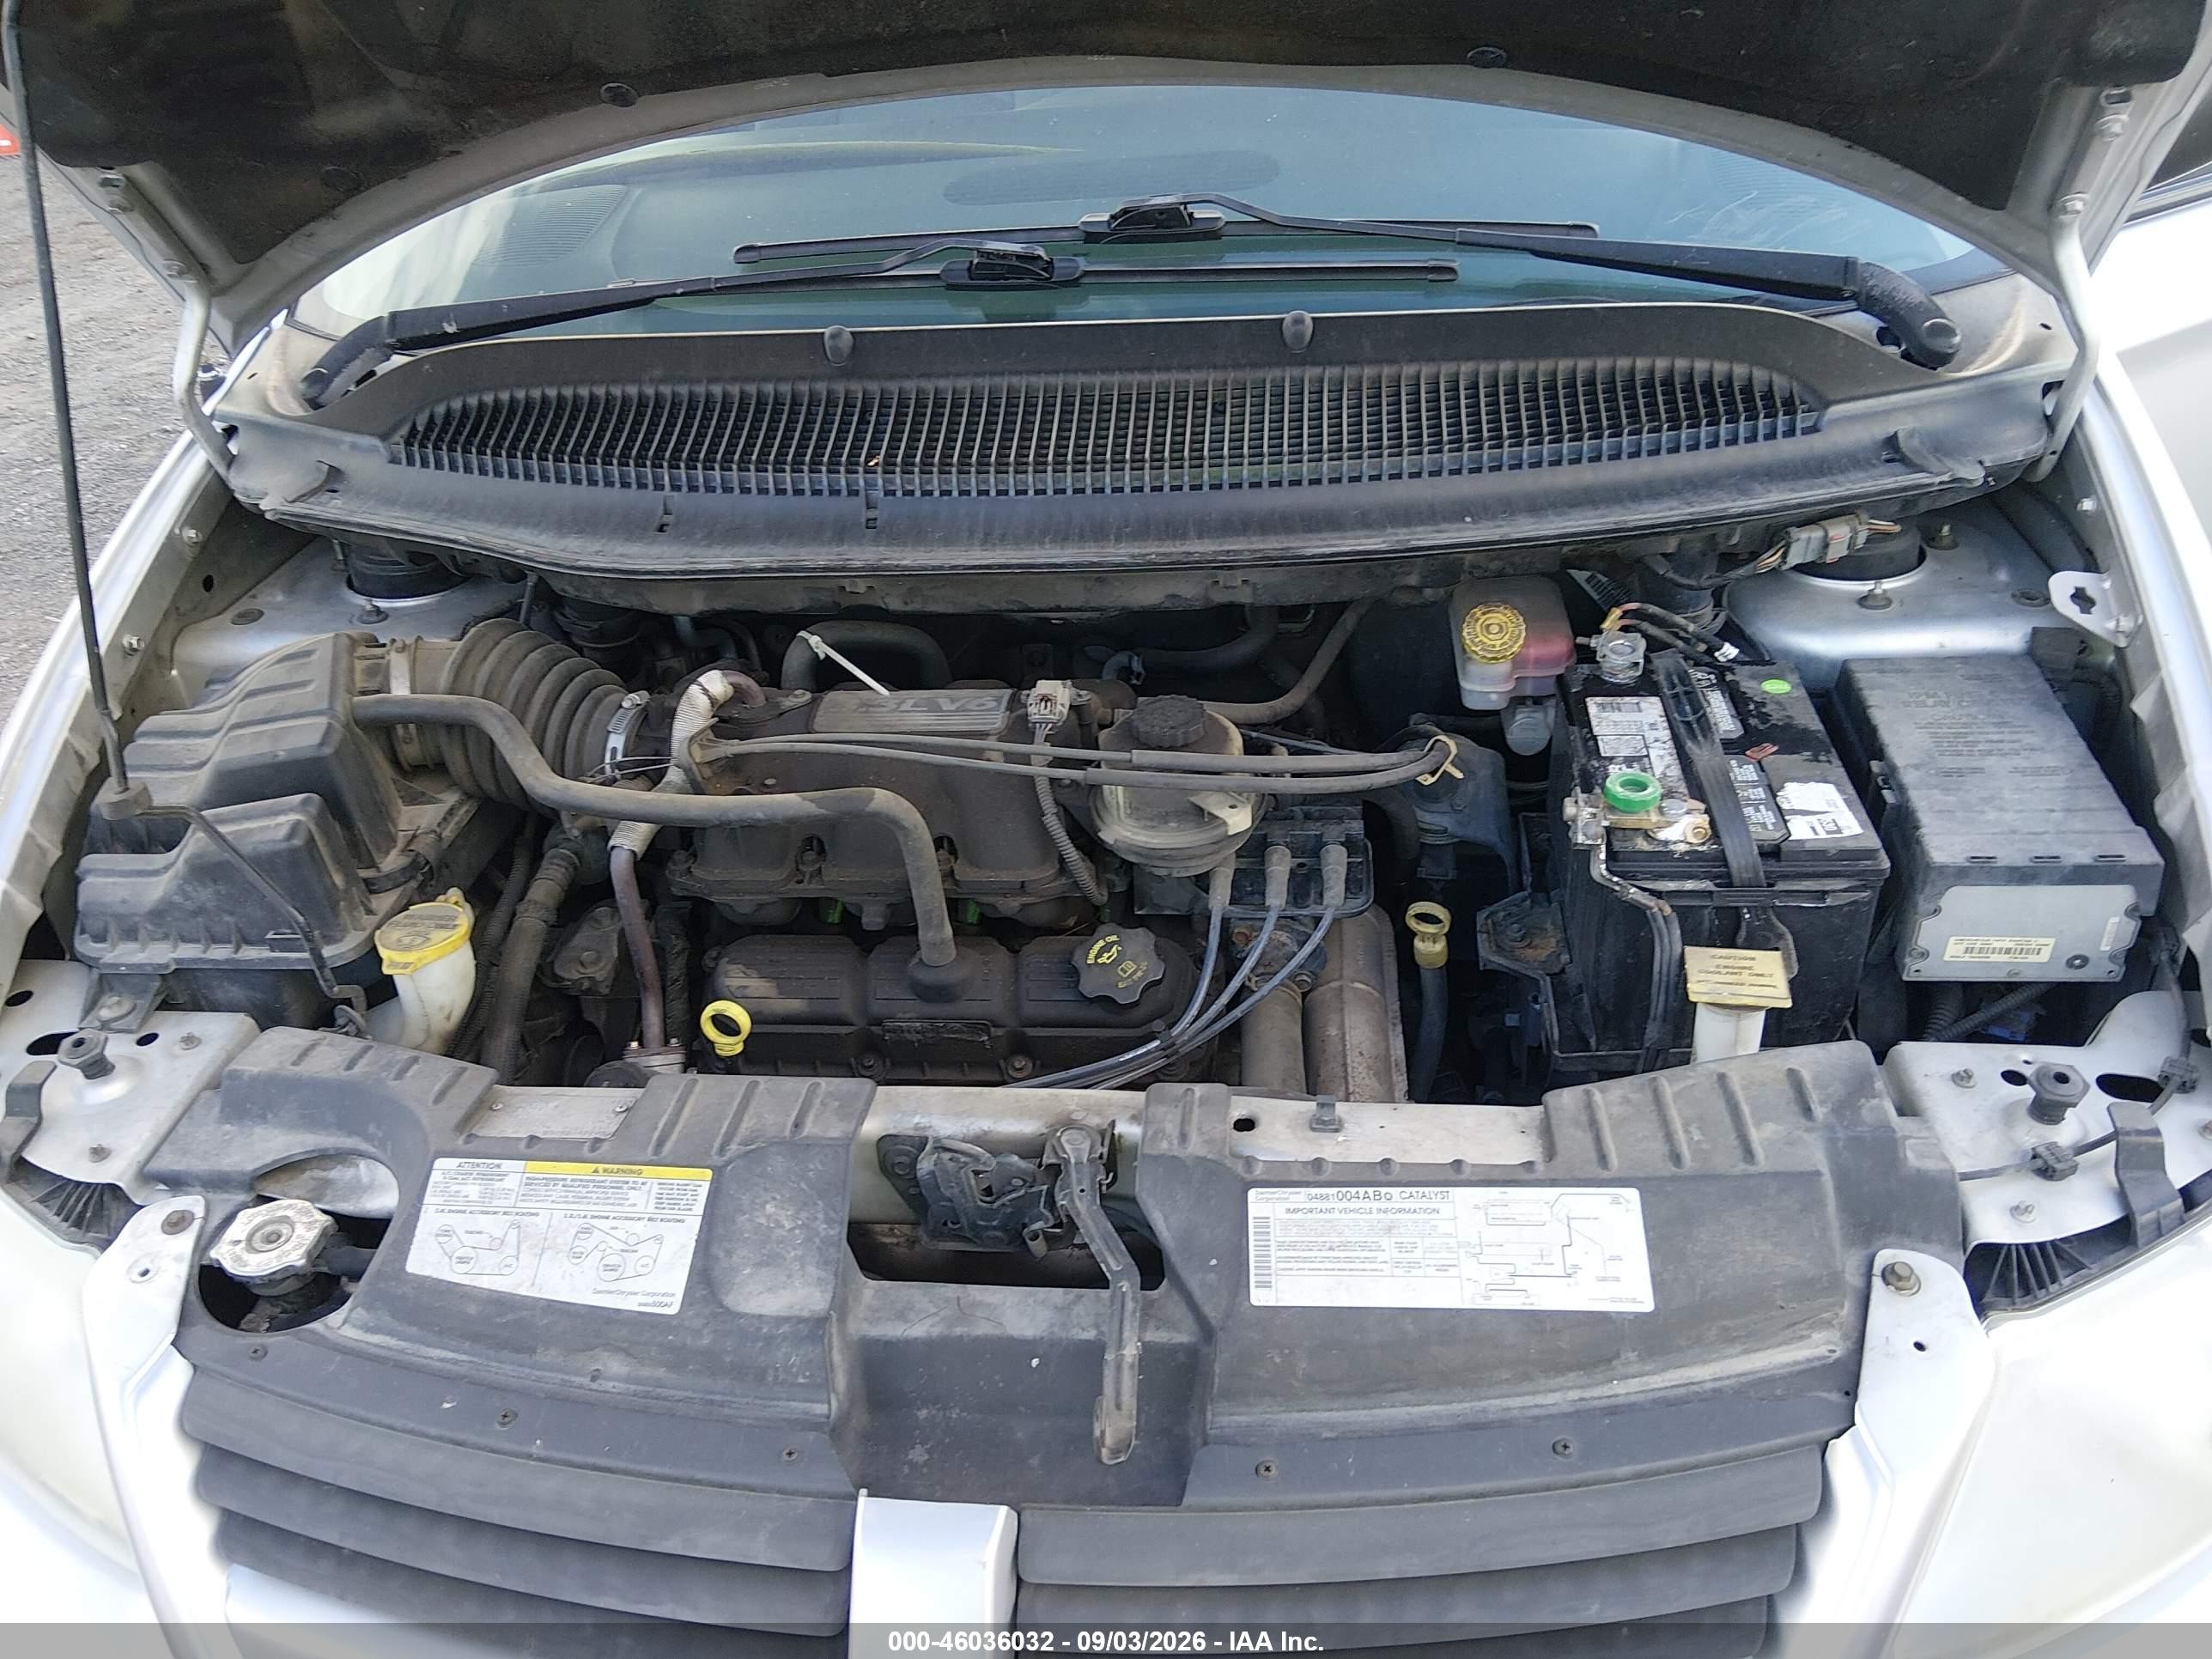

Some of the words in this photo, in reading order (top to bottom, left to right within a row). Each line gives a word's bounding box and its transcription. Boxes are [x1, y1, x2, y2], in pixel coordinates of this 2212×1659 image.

[938, 696, 998, 711] V6
[1086, 938, 1107, 964] ENGINE
[1104, 934, 1121, 943] OIL
[601, 1167, 644, 1176] WARNING
[1398, 1190, 1450, 1200] CATALYST
